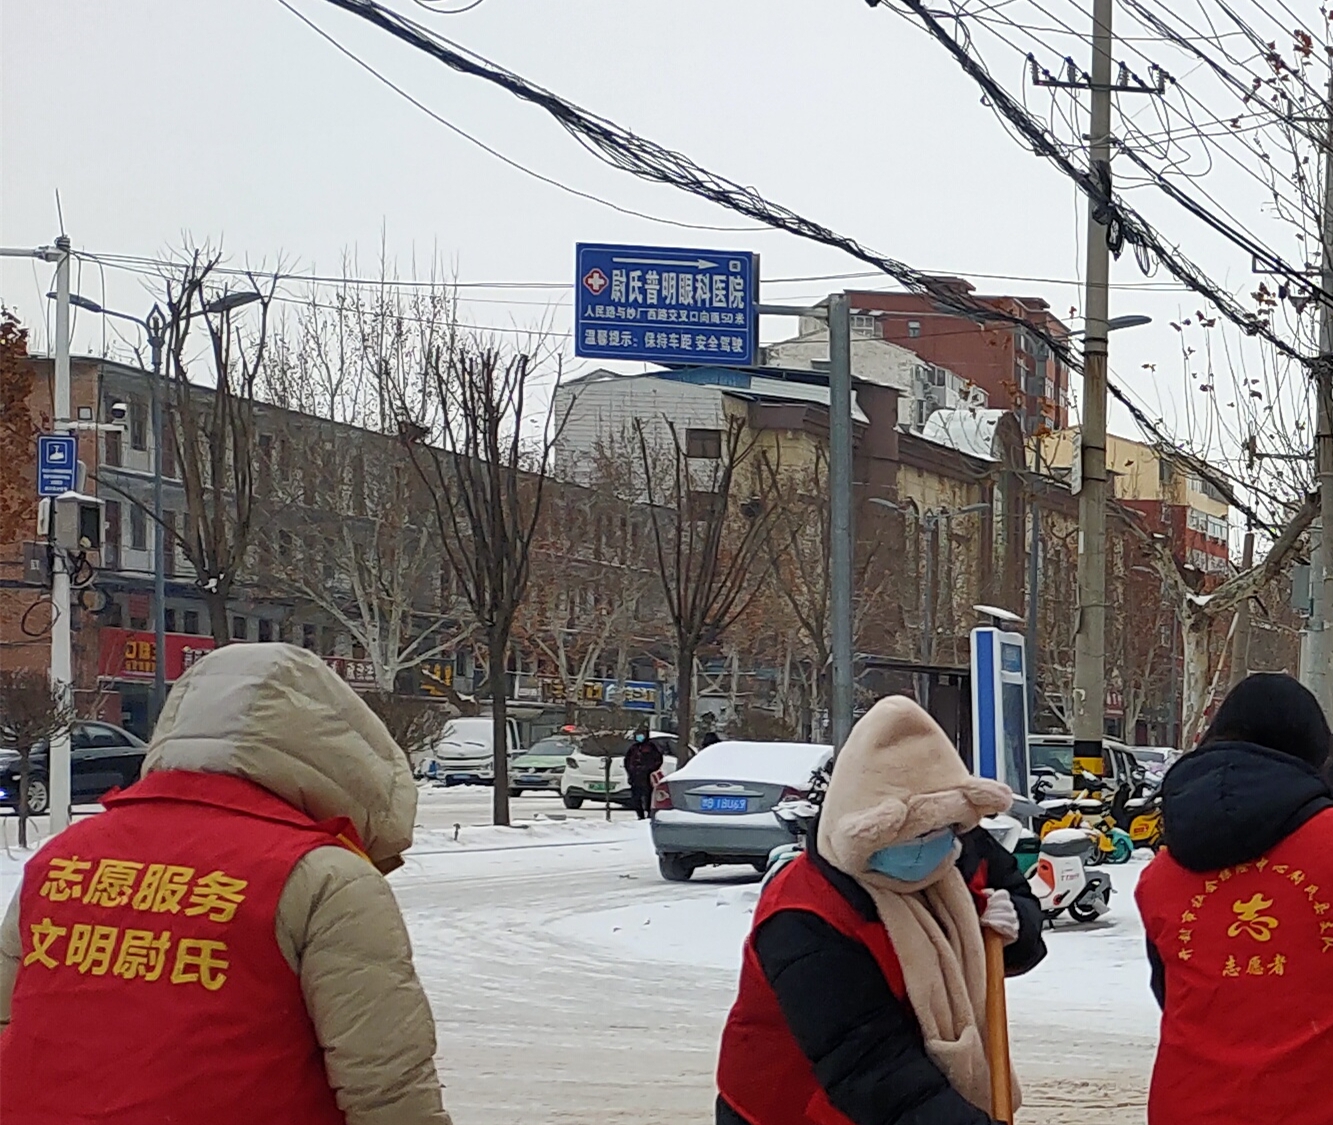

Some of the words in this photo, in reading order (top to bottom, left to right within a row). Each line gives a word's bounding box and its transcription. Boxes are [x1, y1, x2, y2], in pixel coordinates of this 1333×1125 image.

[611, 269, 744, 309] 尉氏普明眼科医院
[644, 332, 693, 350] 保持车距
[695, 334, 743, 353] 安全驾驶
[40, 855, 249, 923] 志愿服务
[23, 917, 230, 991] 文明尉氏
[1222, 953, 1288, 977] 志愿者
